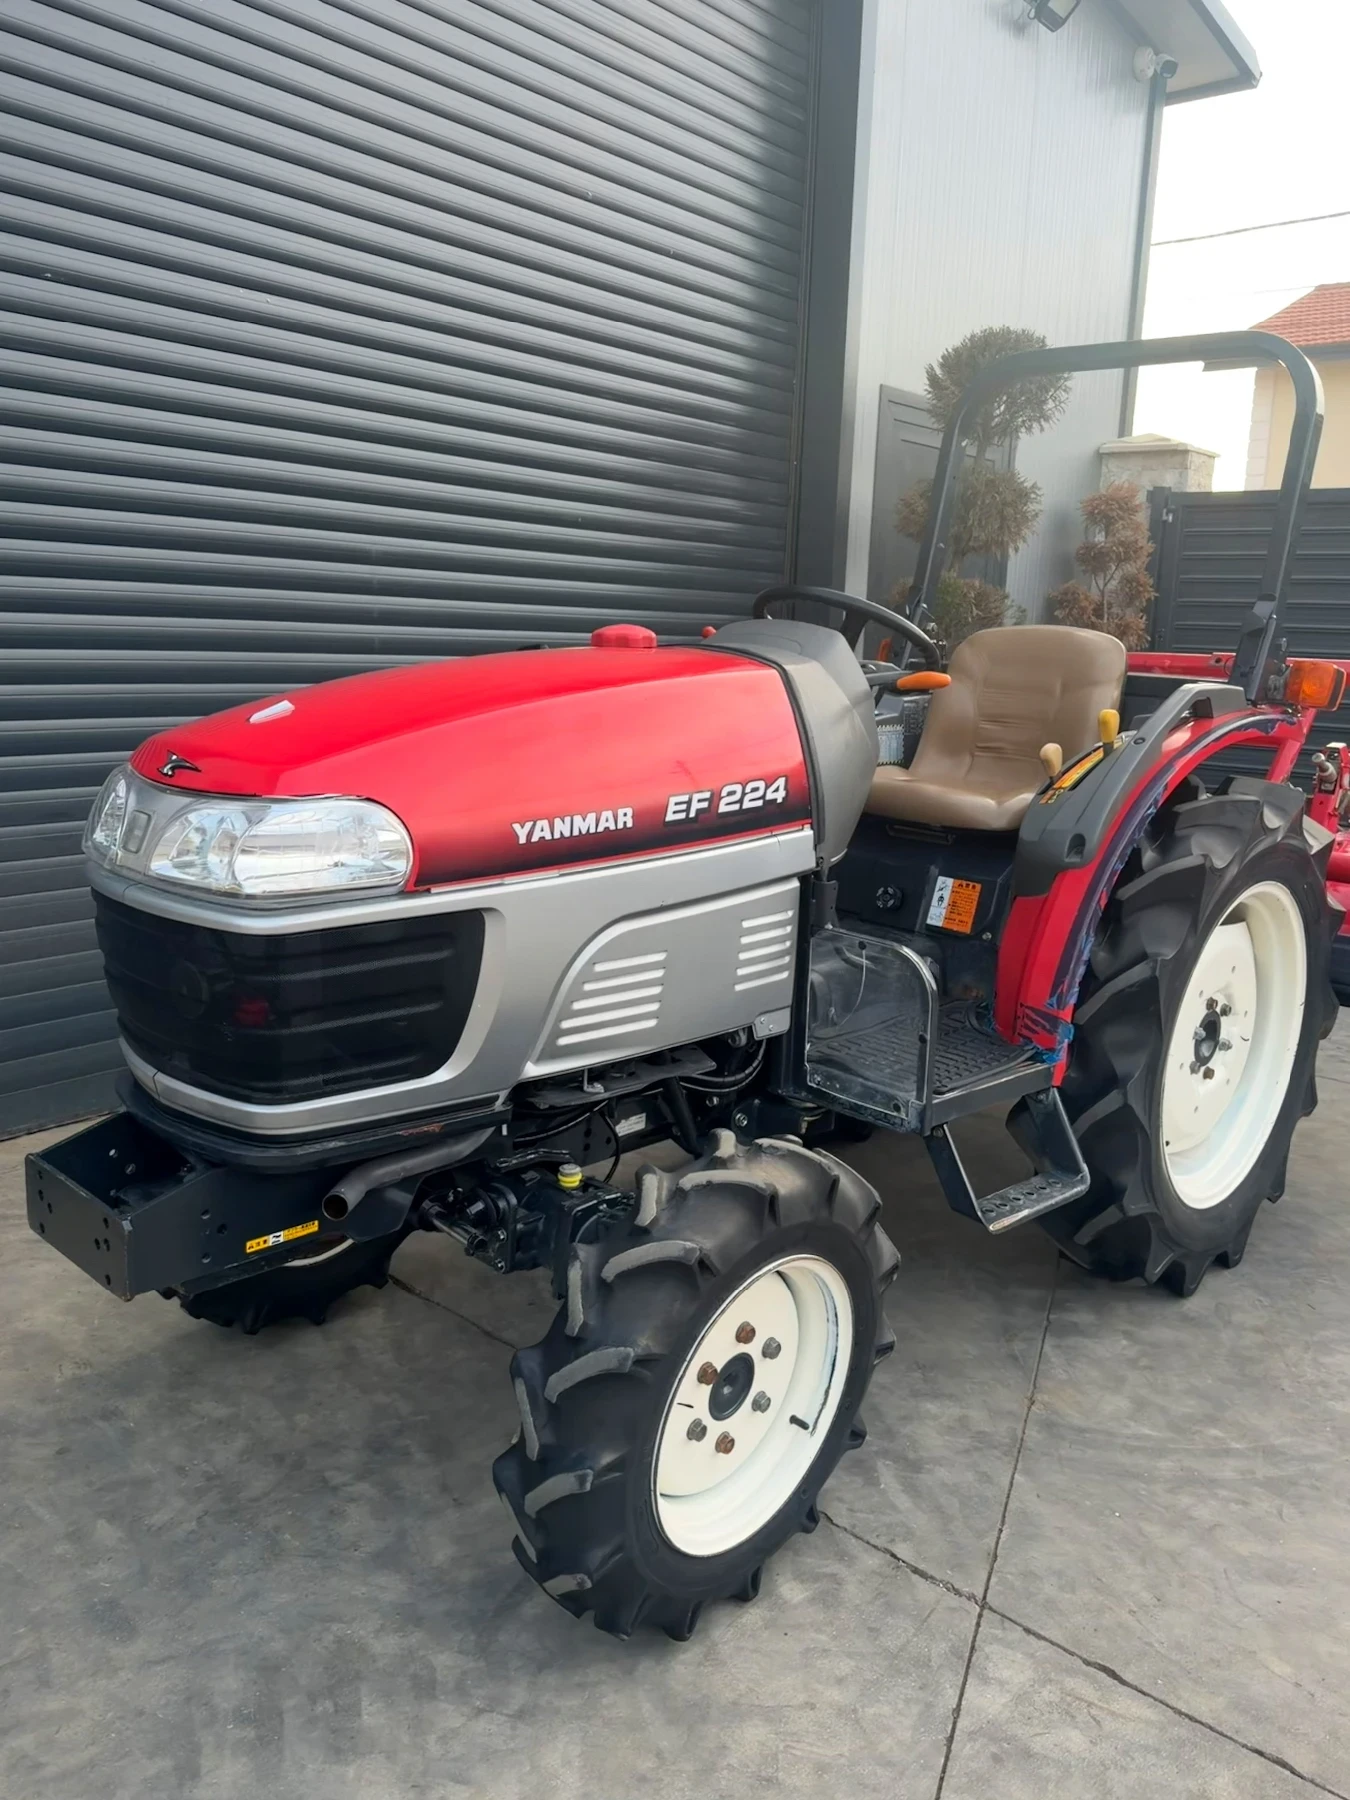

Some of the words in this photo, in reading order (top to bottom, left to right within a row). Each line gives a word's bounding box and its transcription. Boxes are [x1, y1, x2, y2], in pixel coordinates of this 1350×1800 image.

[664, 790, 712, 822] EF
[717, 775, 787, 814] 224
[512, 807, 633, 844] YANMAR
